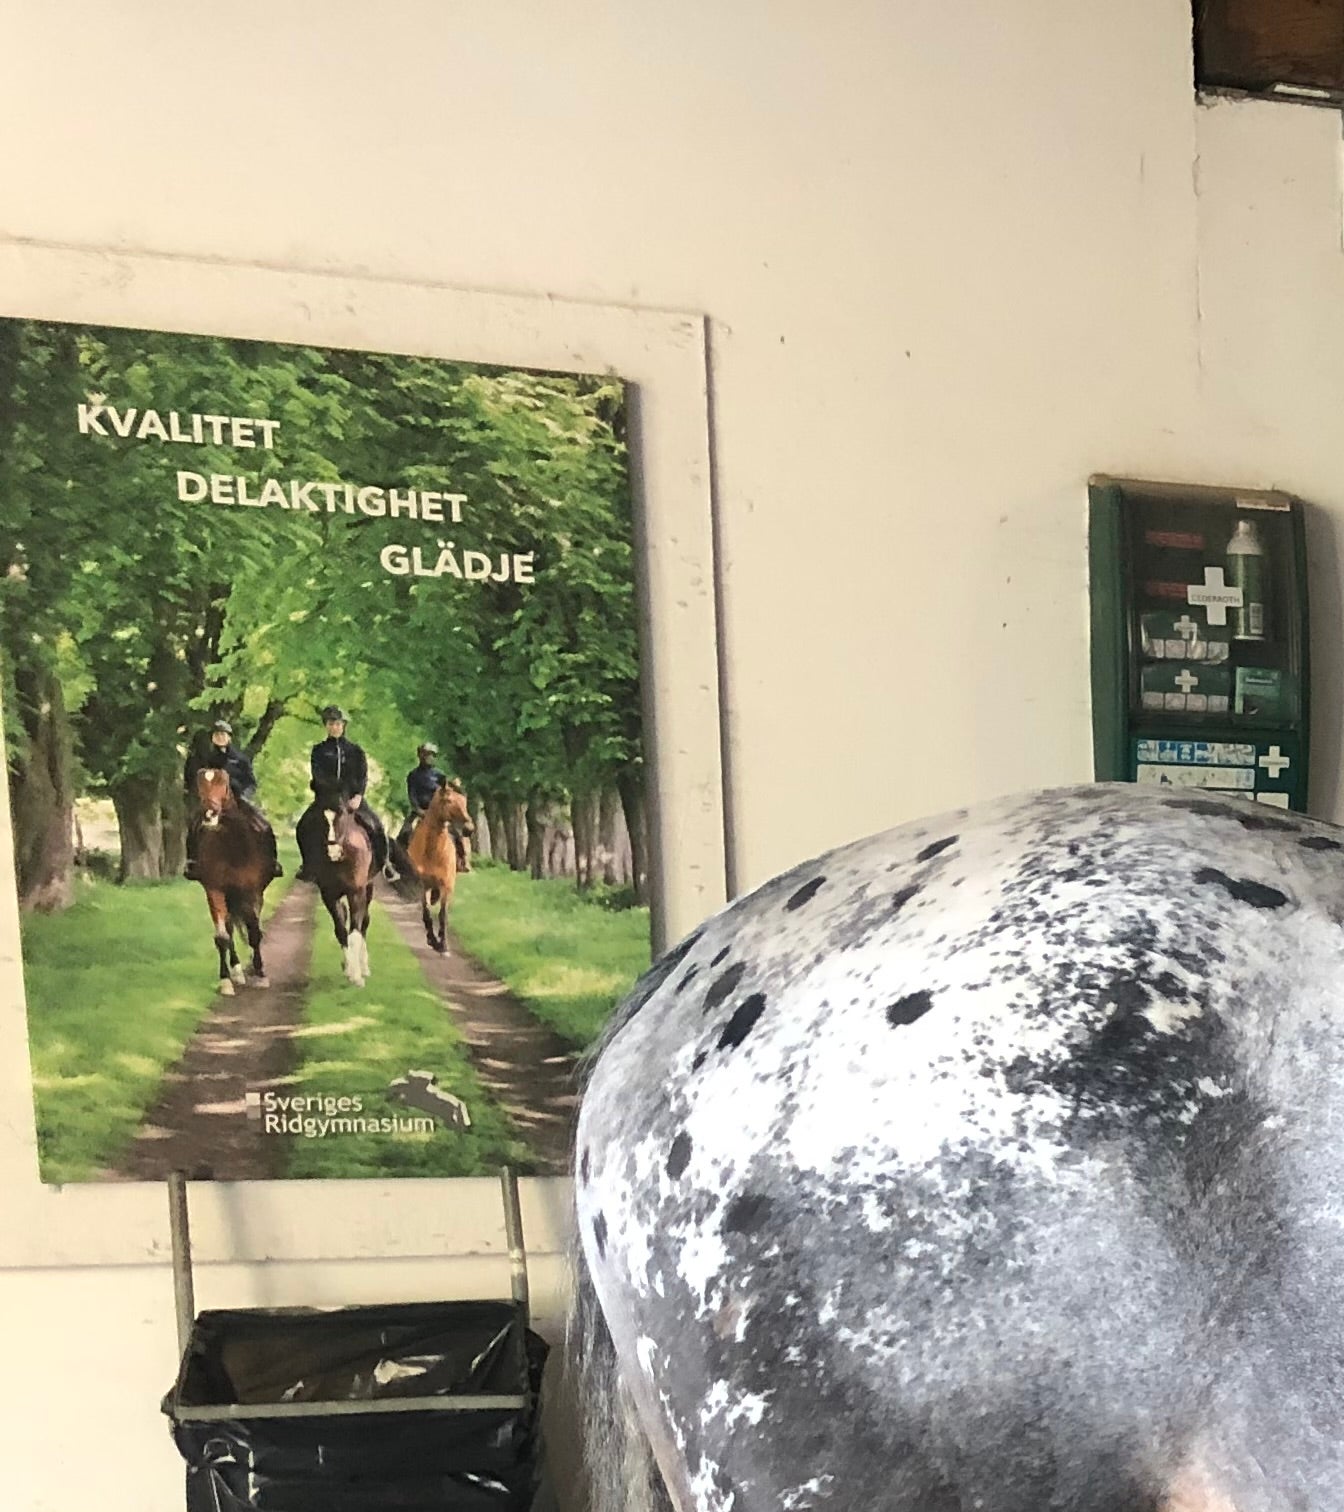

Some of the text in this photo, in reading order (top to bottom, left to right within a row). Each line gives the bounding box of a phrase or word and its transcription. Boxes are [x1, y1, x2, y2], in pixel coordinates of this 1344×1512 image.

[78, 403, 281, 450] KVALITET
[177, 470, 468, 523] DELAKTIGHET
[379, 541, 535, 584] GLÄDJE
[263, 1091, 363, 1117] Sveriges
[264, 1113, 435, 1139] Ridgymnasium
